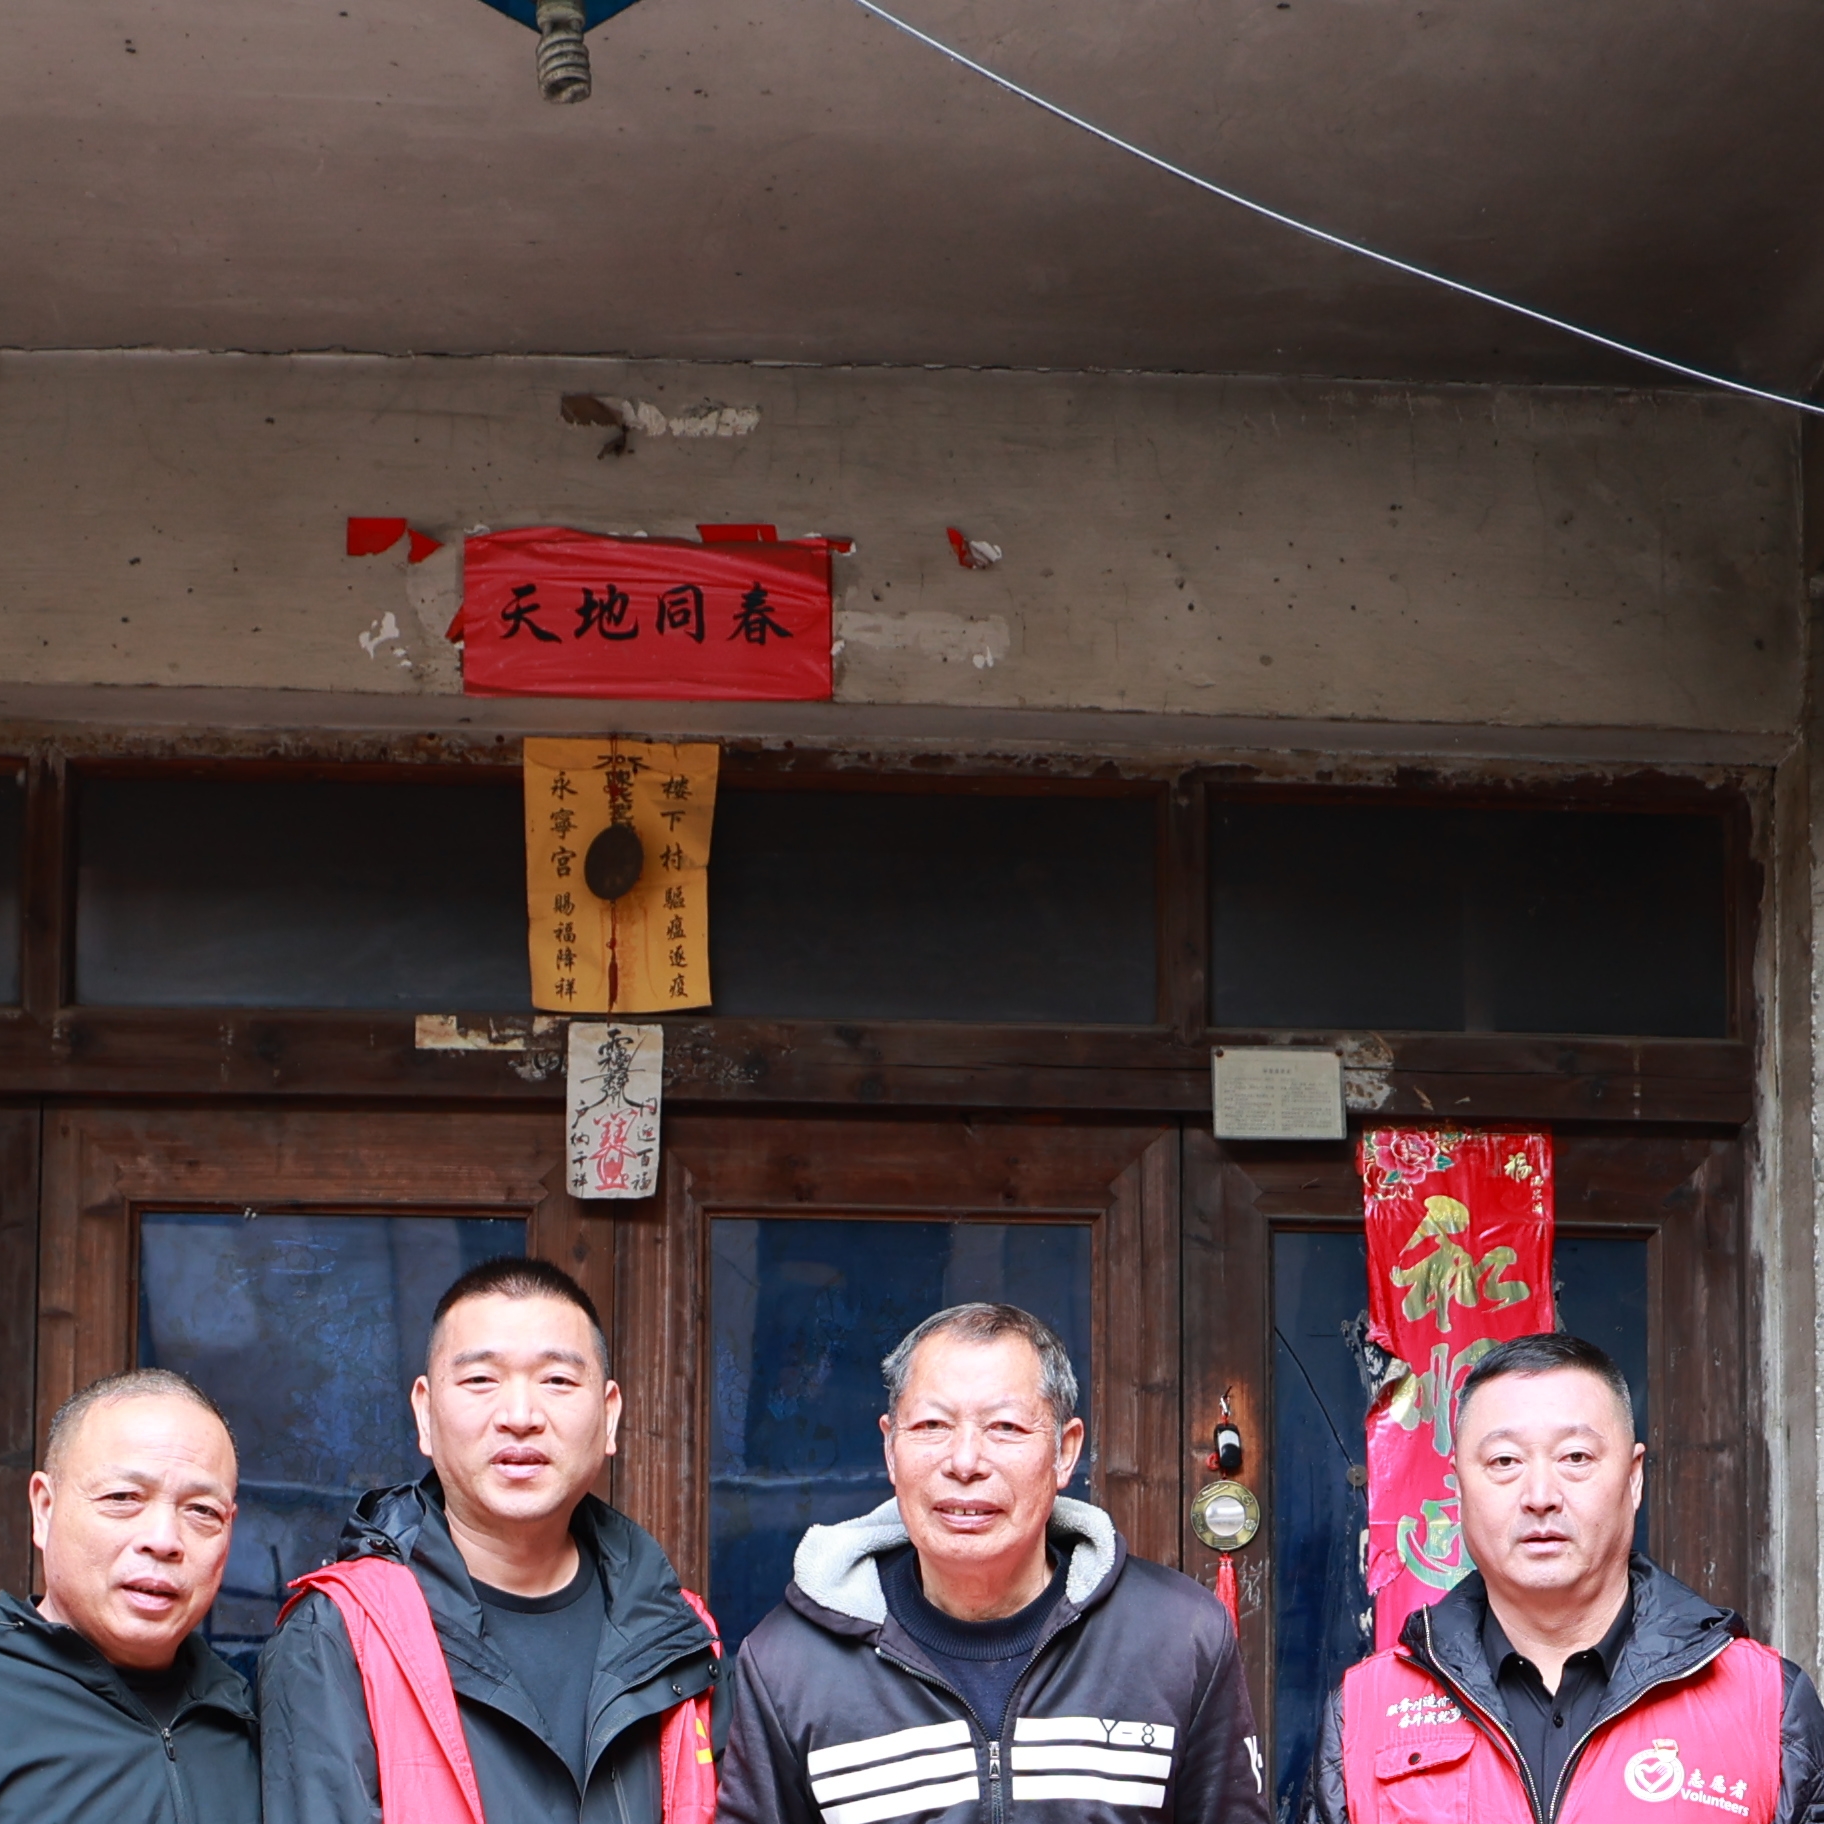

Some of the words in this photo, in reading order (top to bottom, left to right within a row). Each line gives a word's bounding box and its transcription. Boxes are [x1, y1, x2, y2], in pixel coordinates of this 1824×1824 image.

[498, 581, 795, 646] 天地同春
[1687, 1768, 1749, 1800] 志愿者
[1680, 1787, 1750, 1817] Volunteers
